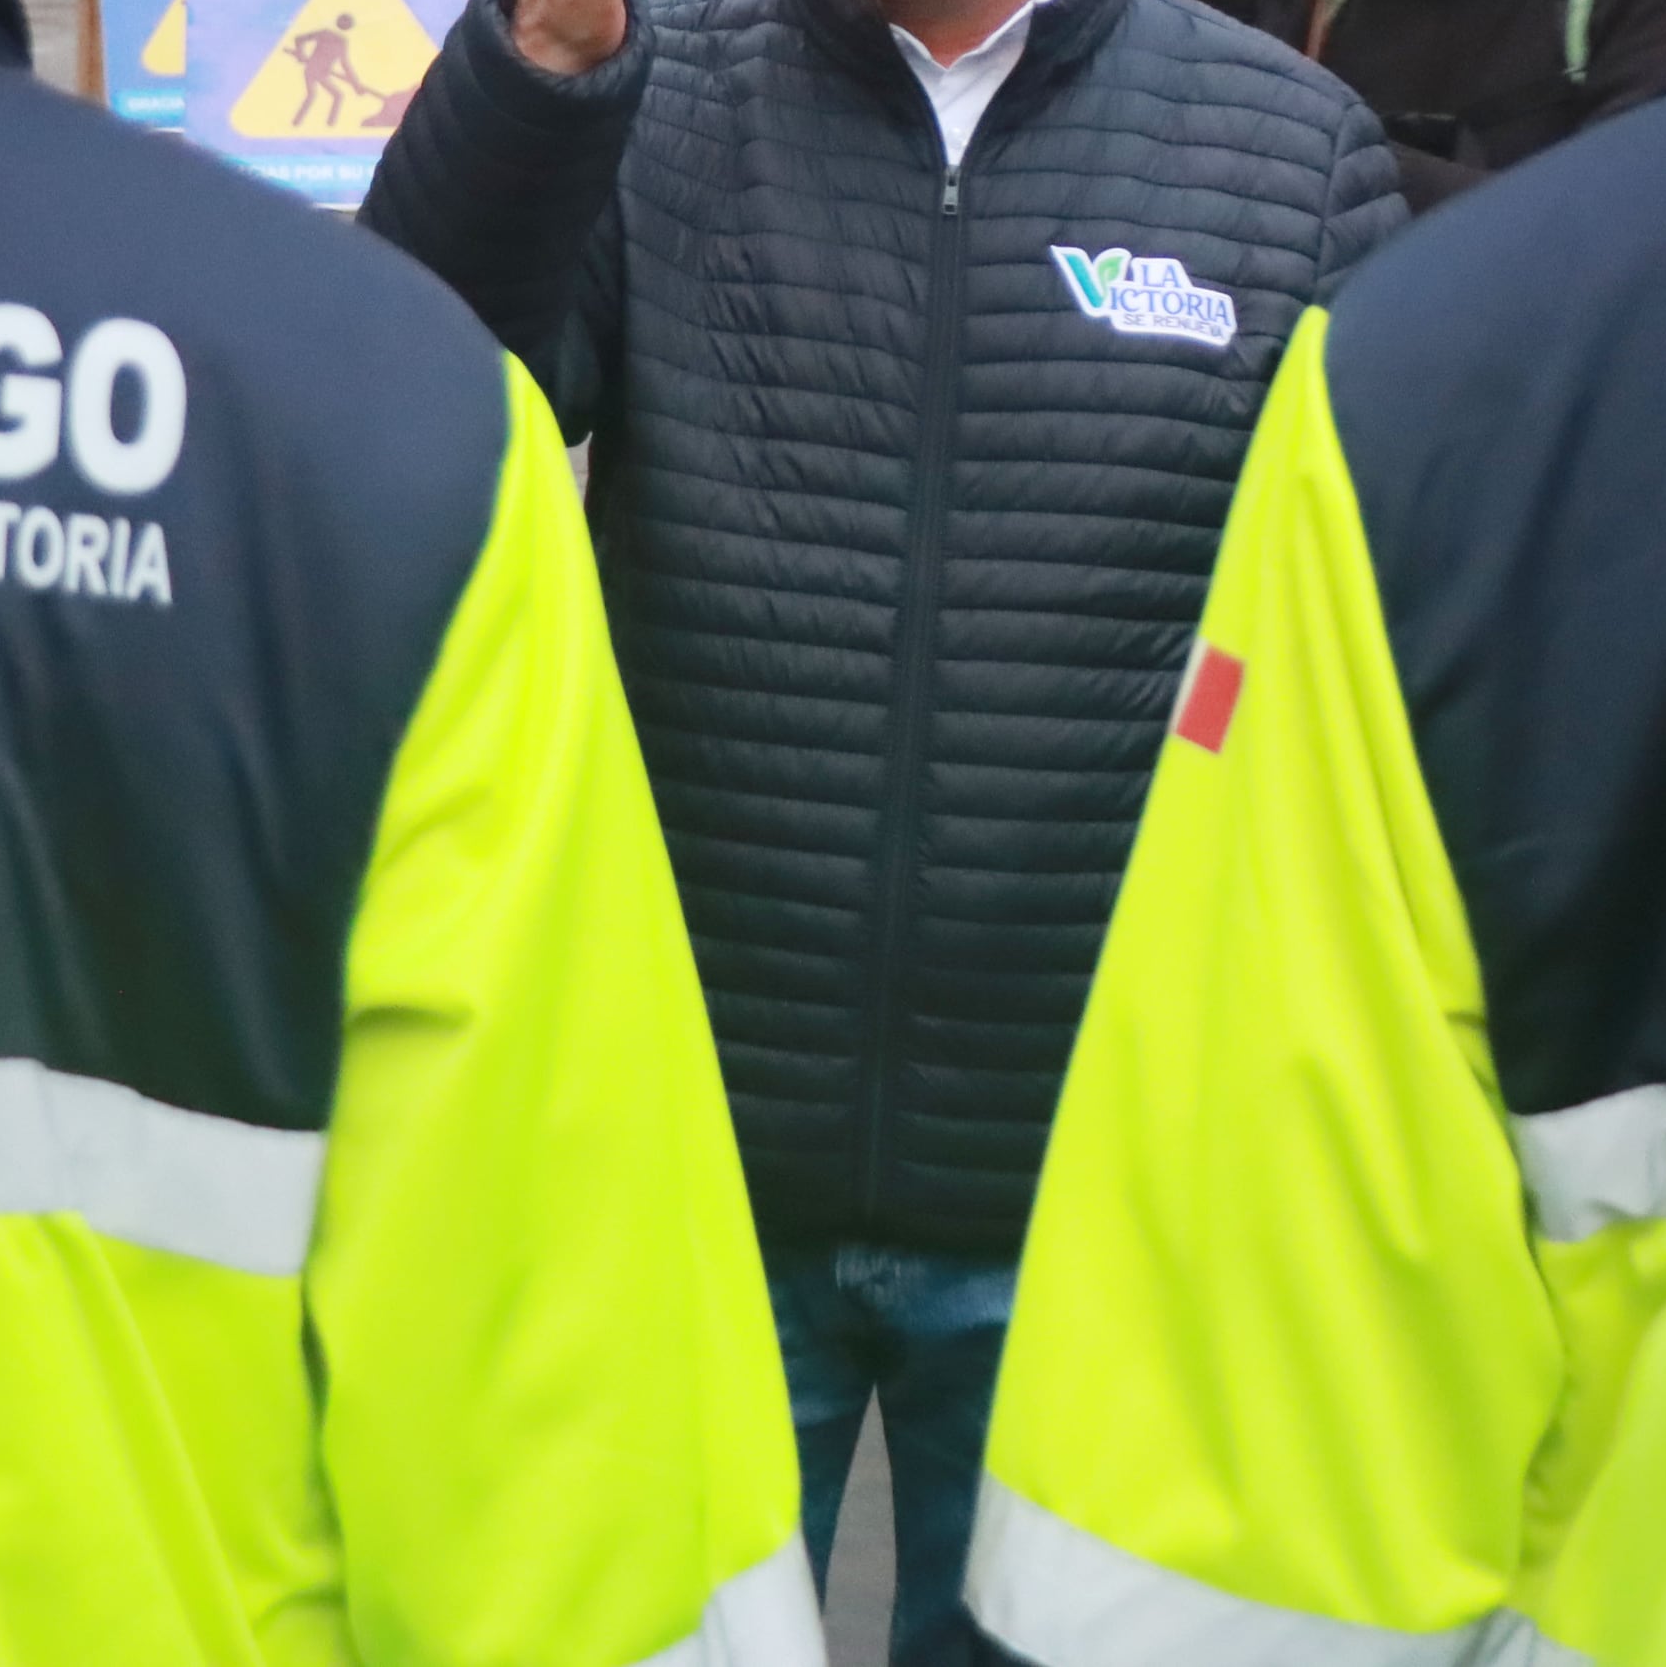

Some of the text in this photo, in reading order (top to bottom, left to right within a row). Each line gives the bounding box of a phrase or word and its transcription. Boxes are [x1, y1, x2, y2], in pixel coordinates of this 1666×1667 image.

[1063, 253, 1231, 327] VICTORIA
[1141, 263, 1181, 290] LA
[1122, 312, 1147, 327] SE
